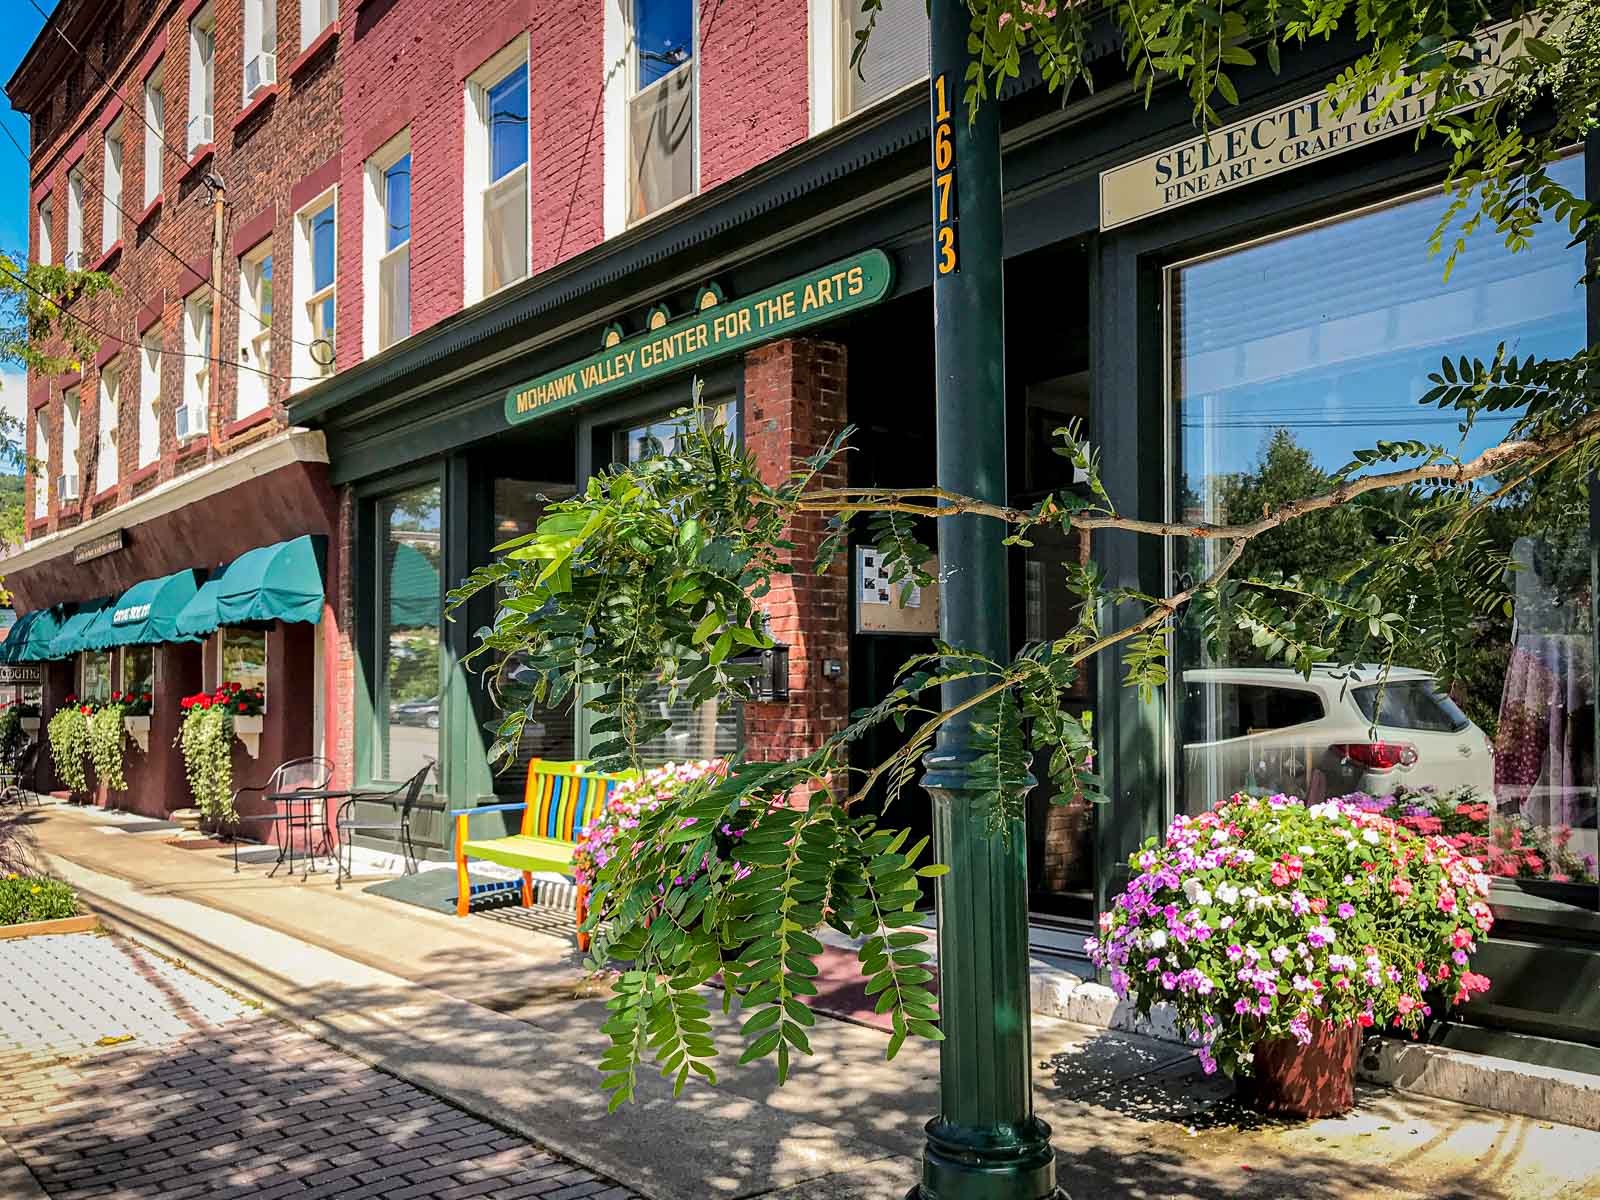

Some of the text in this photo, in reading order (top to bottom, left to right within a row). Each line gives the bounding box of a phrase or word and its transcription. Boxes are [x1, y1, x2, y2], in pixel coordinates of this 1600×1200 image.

[935, 75, 957, 274] 1673
[1164, 173, 1210, 204] FINE
[1215, 157, 1257, 187] ART
[1278, 122, 1357, 164] CRAFT
[516, 266, 864, 414] MOHAWK VALLEY CENTER FOR THE ARTS
